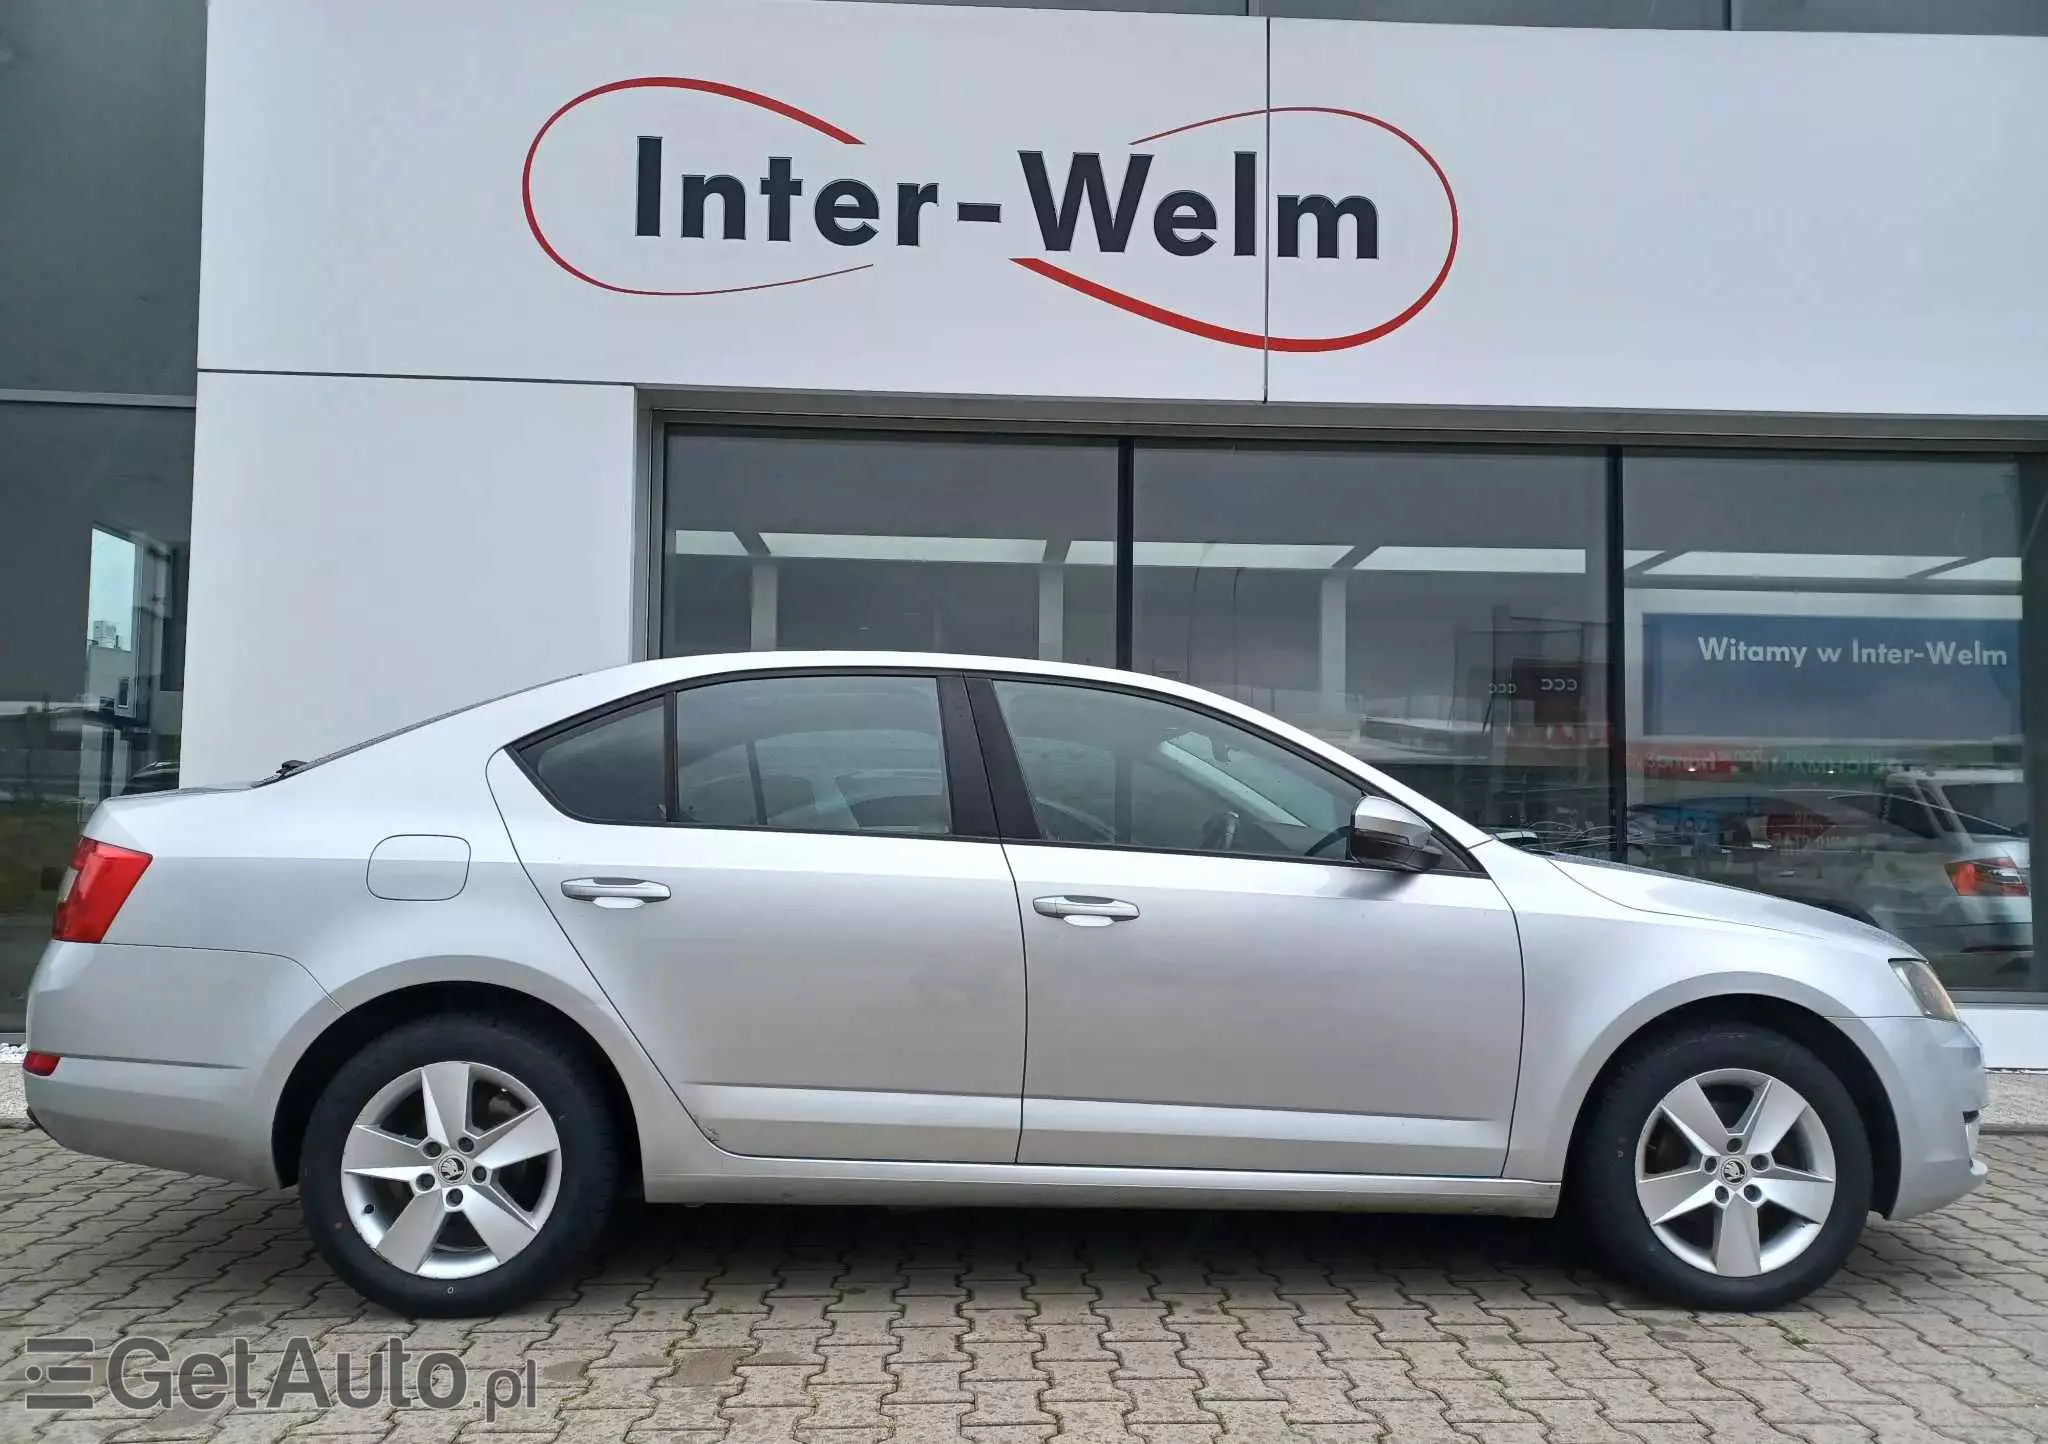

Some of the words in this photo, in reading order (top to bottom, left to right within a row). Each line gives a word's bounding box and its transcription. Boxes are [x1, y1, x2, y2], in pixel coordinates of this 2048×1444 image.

[636, 135, 1380, 259] Inter-Welm
[1698, 637, 1807, 668] Witamy
[1817, 647, 1842, 662] w
[1852, 638, 2007, 666] Inter-Welm
